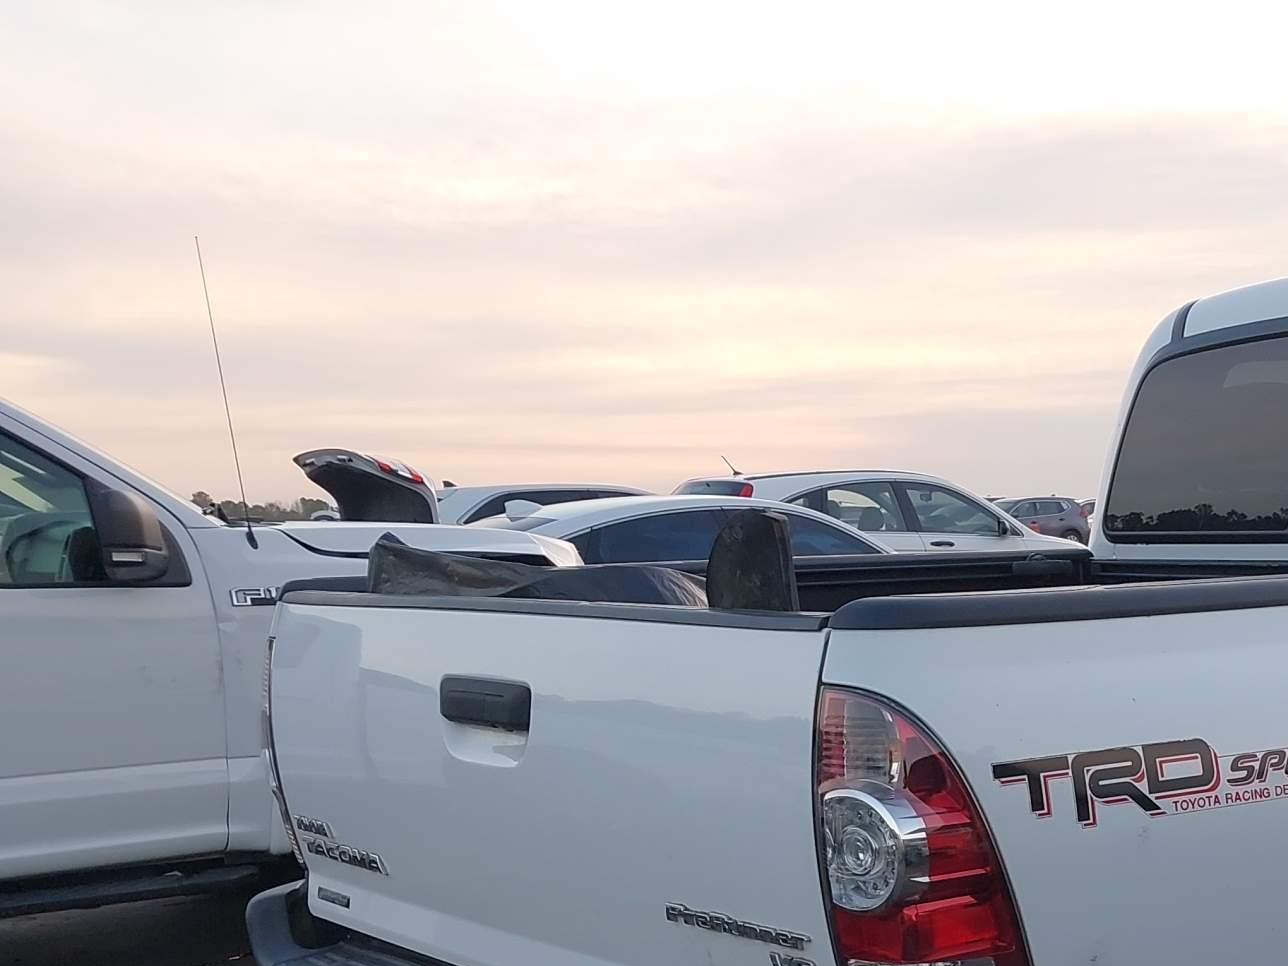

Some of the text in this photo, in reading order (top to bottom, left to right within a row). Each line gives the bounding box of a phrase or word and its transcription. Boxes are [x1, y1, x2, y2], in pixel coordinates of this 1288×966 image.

[992, 739, 1221, 828] TRD
[1172, 796, 1222, 813] TOYOTA
[1225, 786, 1271, 804] RACING
[303, 835, 389, 876] TACOMA
